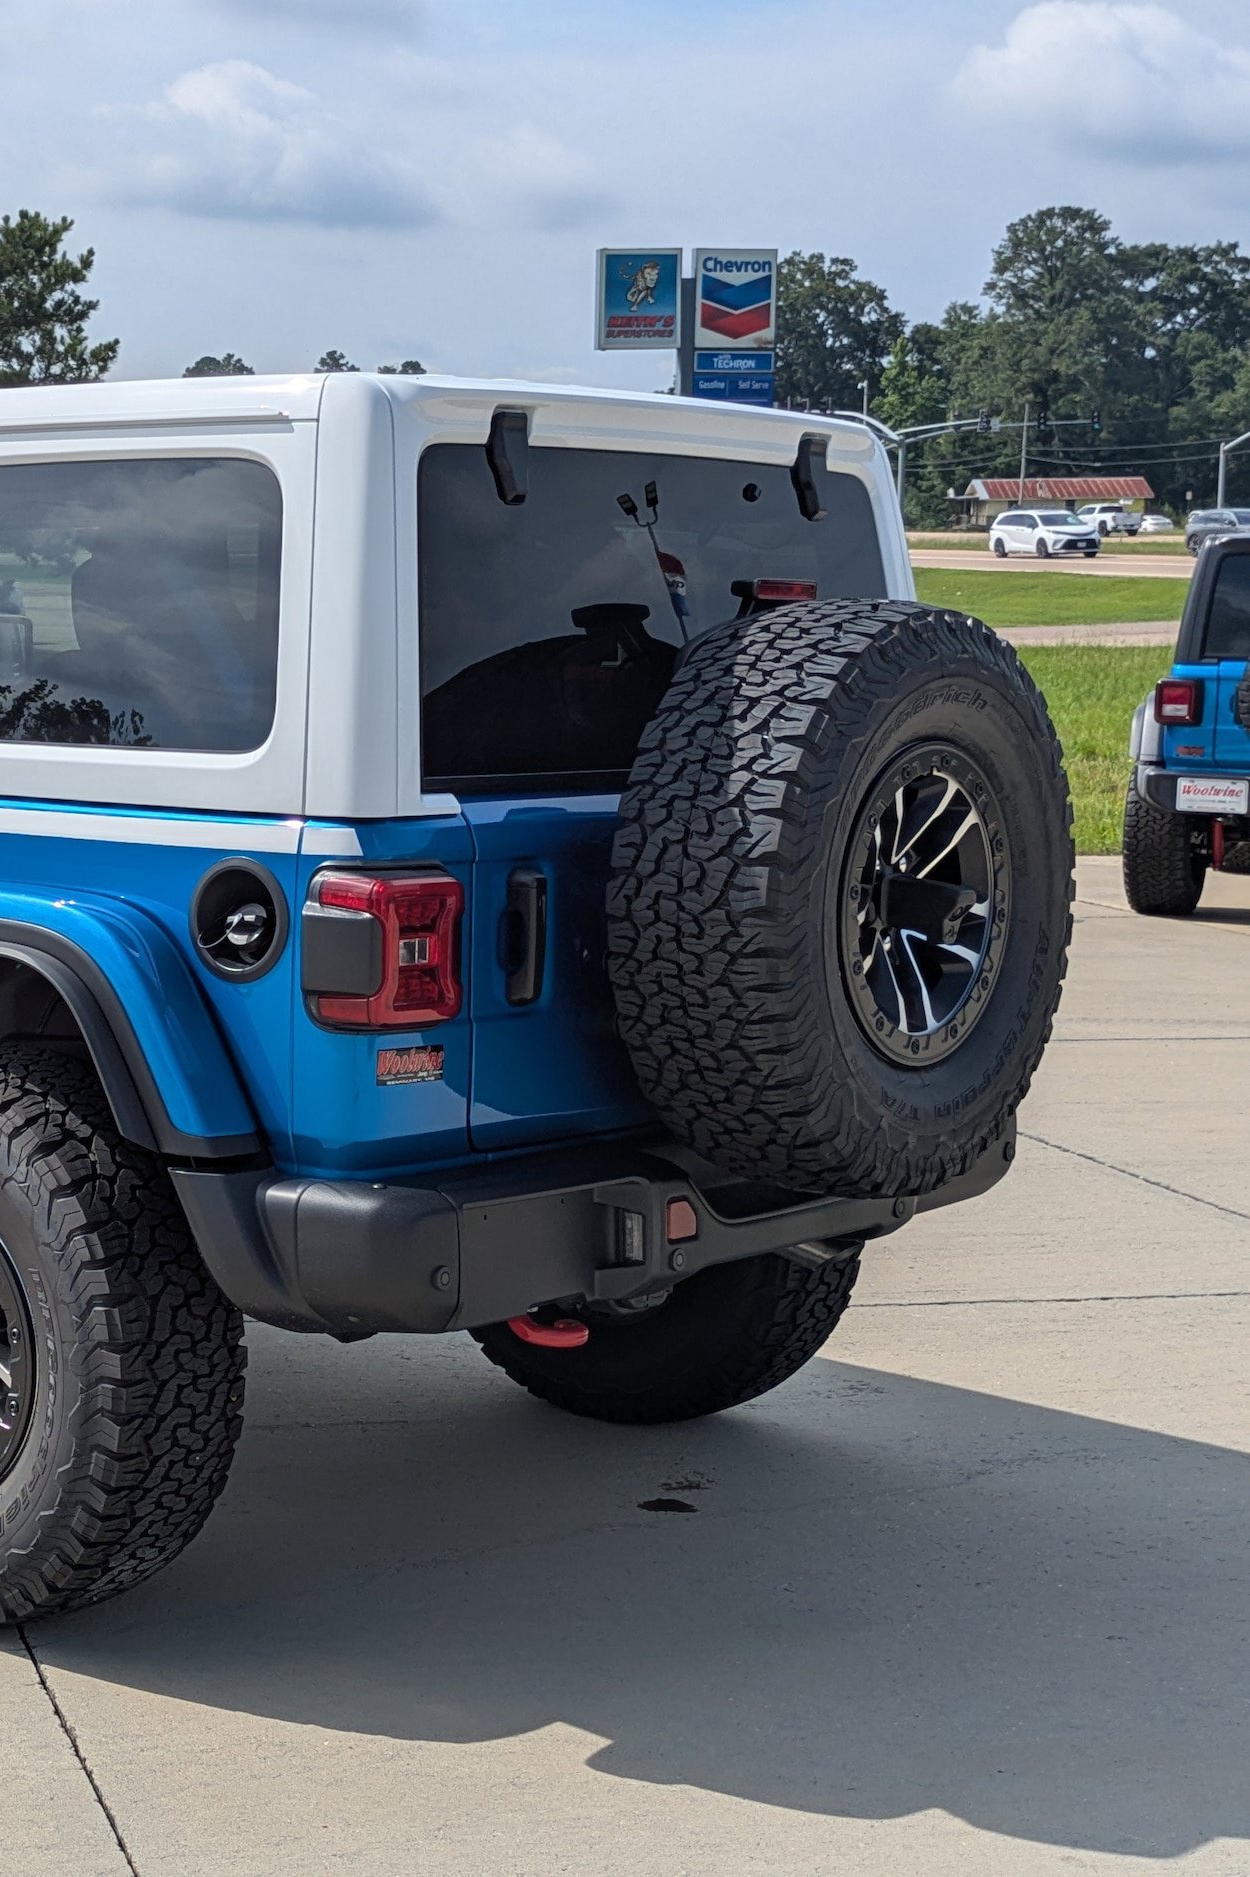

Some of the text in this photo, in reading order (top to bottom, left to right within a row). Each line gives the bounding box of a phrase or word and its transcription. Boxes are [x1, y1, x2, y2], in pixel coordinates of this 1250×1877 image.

[702, 256, 772, 273] Chevron
[607, 315, 676, 328] KEITH'S
[605, 329, 674, 338] SUPERSTORES
[713, 358, 756, 369] TECHRON
[699, 381, 725, 389] Gasoline
[738, 380, 769, 389] Self Serve
[1182, 783, 1244, 798] Woolwine
[378, 1046, 444, 1074] Woolwine
